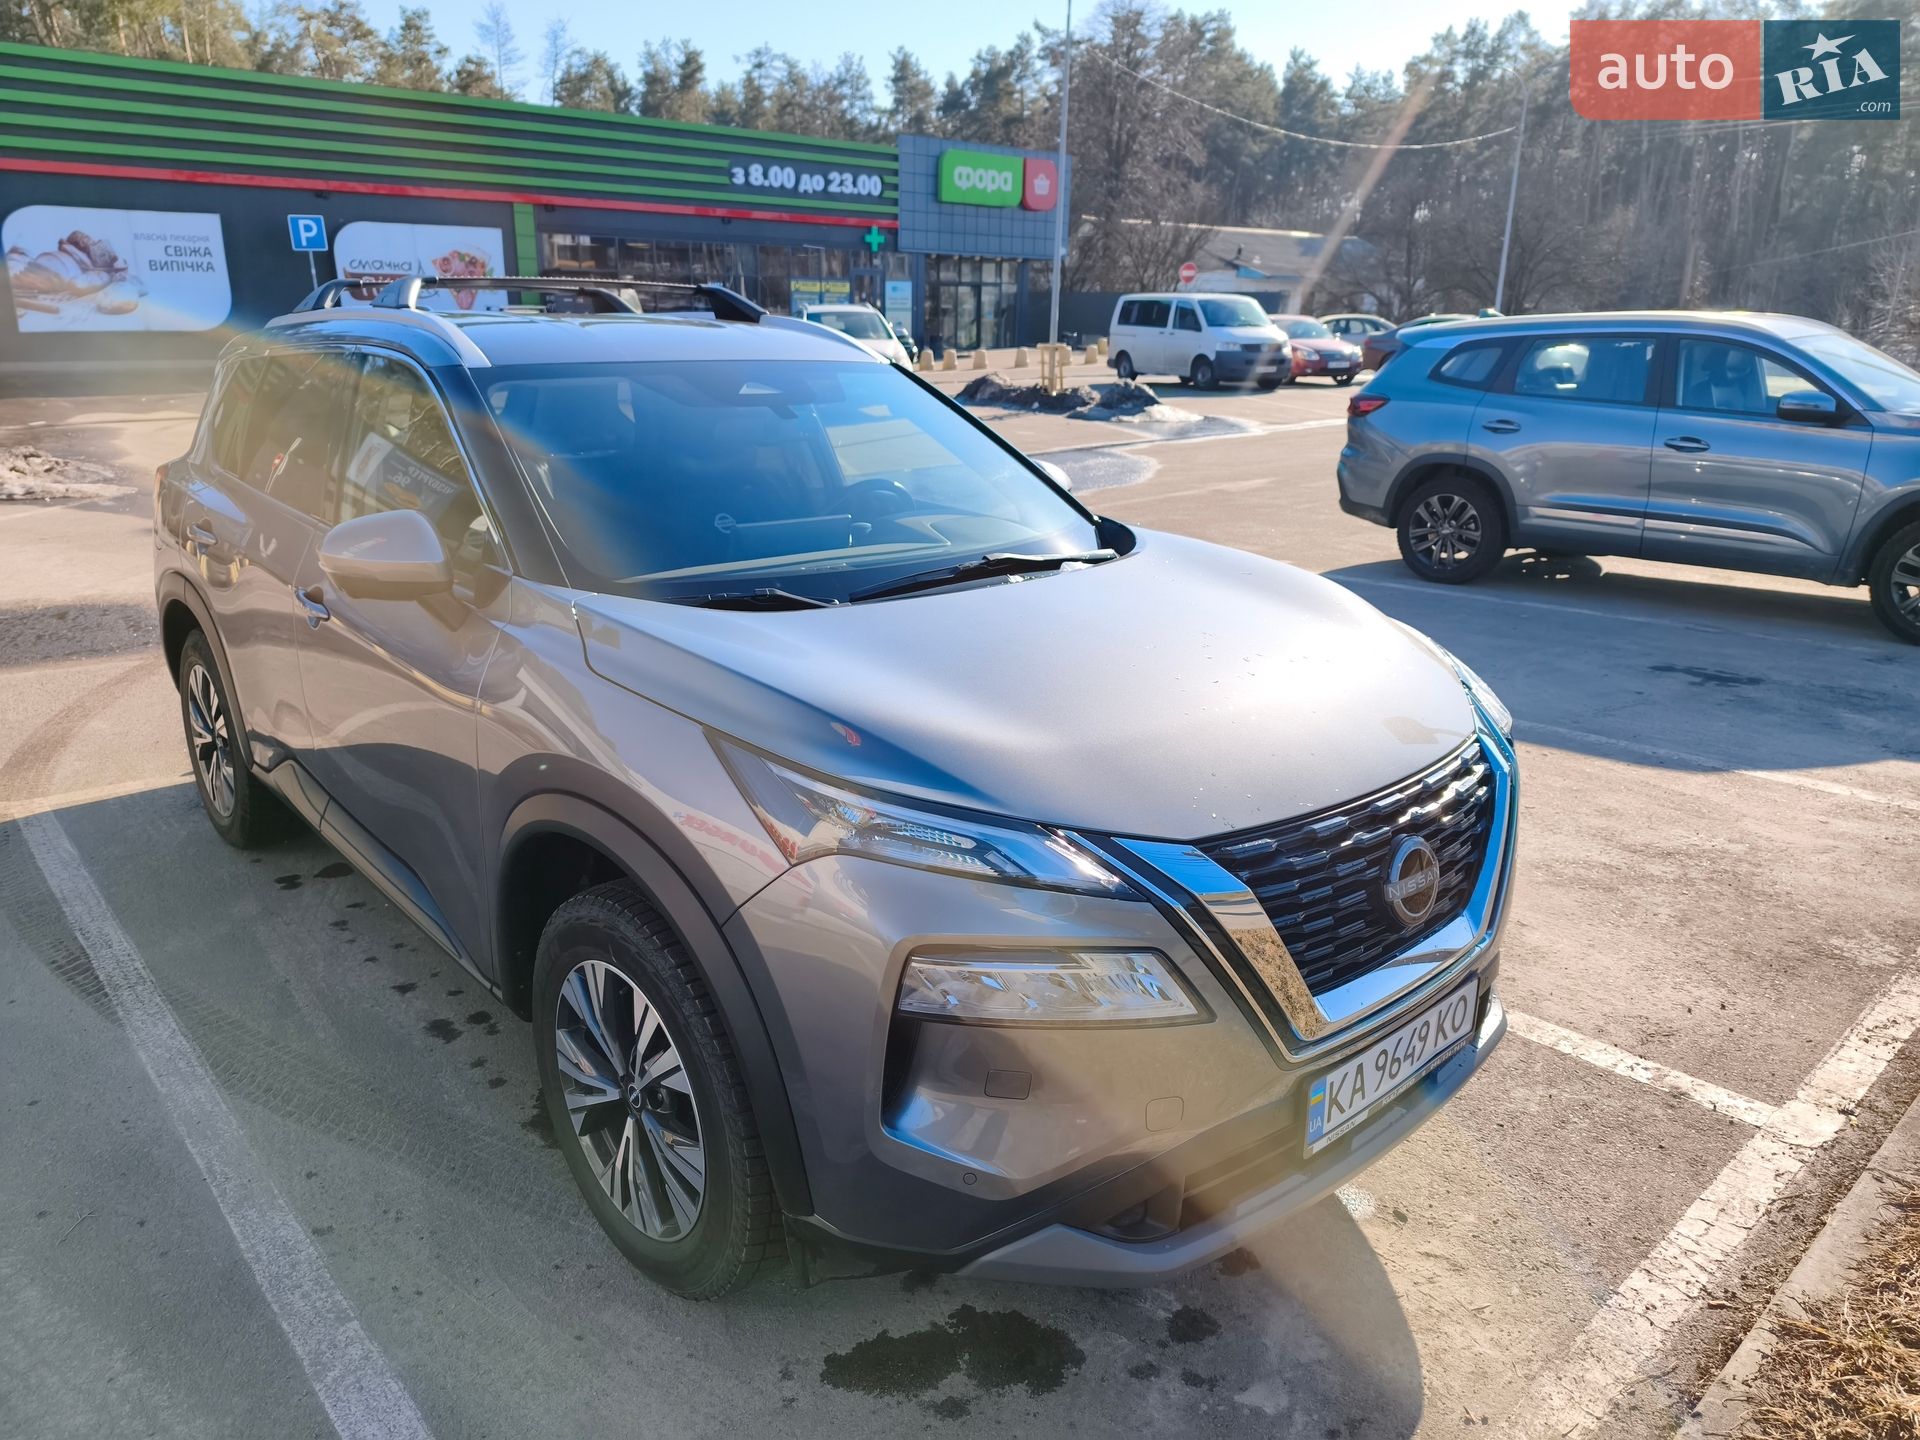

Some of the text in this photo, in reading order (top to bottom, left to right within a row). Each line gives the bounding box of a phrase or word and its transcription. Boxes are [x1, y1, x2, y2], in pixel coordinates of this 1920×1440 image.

[748, 163, 796, 190] 8.00
[798, 173, 825, 194] до
[827, 171, 882, 197] 23.00
[953, 165, 1013, 192] фора
[298, 219, 318, 247] P
[164, 245, 213, 258] СВІЖА
[148, 259, 216, 273] ВИПІЧКА
[1387, 867, 1439, 899] NISSAN
[1326, 1062, 1367, 1123] KA
[1374, 1020, 1430, 1092] 9649
[1434, 994, 1468, 1048] KO
[1309, 1117, 1323, 1133] UA
[1326, 1119, 1358, 1144] NISSAN
